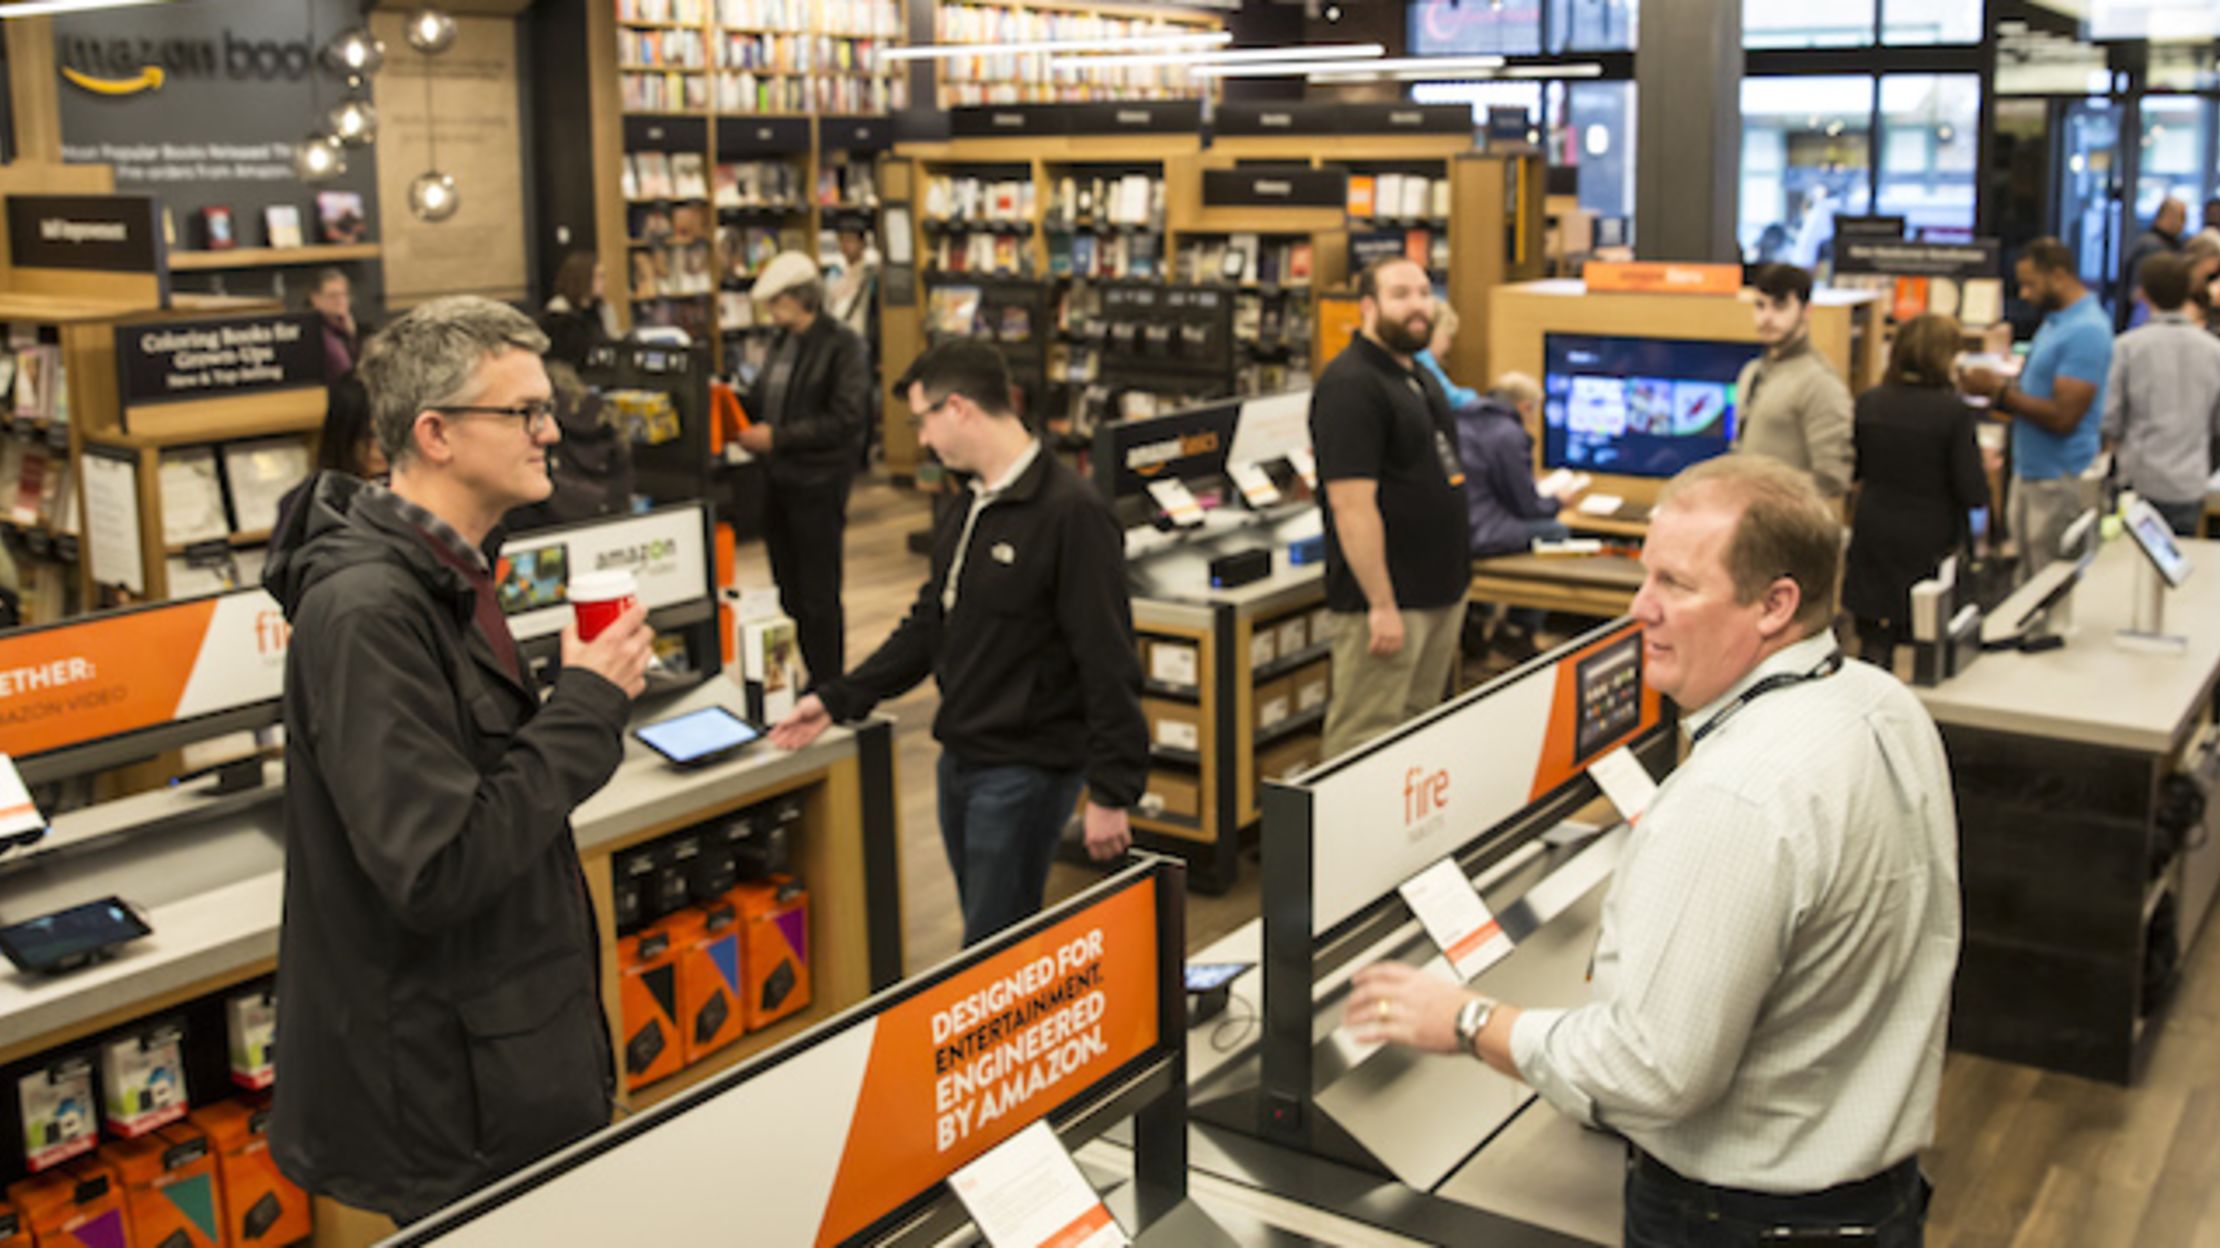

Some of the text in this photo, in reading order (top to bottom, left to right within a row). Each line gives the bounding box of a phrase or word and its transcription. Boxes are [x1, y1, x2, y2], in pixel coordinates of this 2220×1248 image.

[61, 36, 217, 78] mazon
[140, 329, 219, 354] Coloring
[220, 325, 273, 347] Books
[1403, 765, 1450, 827] fire
[931, 928, 1104, 1045] DESIGNED FOR
[934, 964, 1105, 1075] ENTERTAINMENT.
[935, 990, 1106, 1114] ENGINEERED
[936, 1025, 1108, 1153] BY AMAZON.
